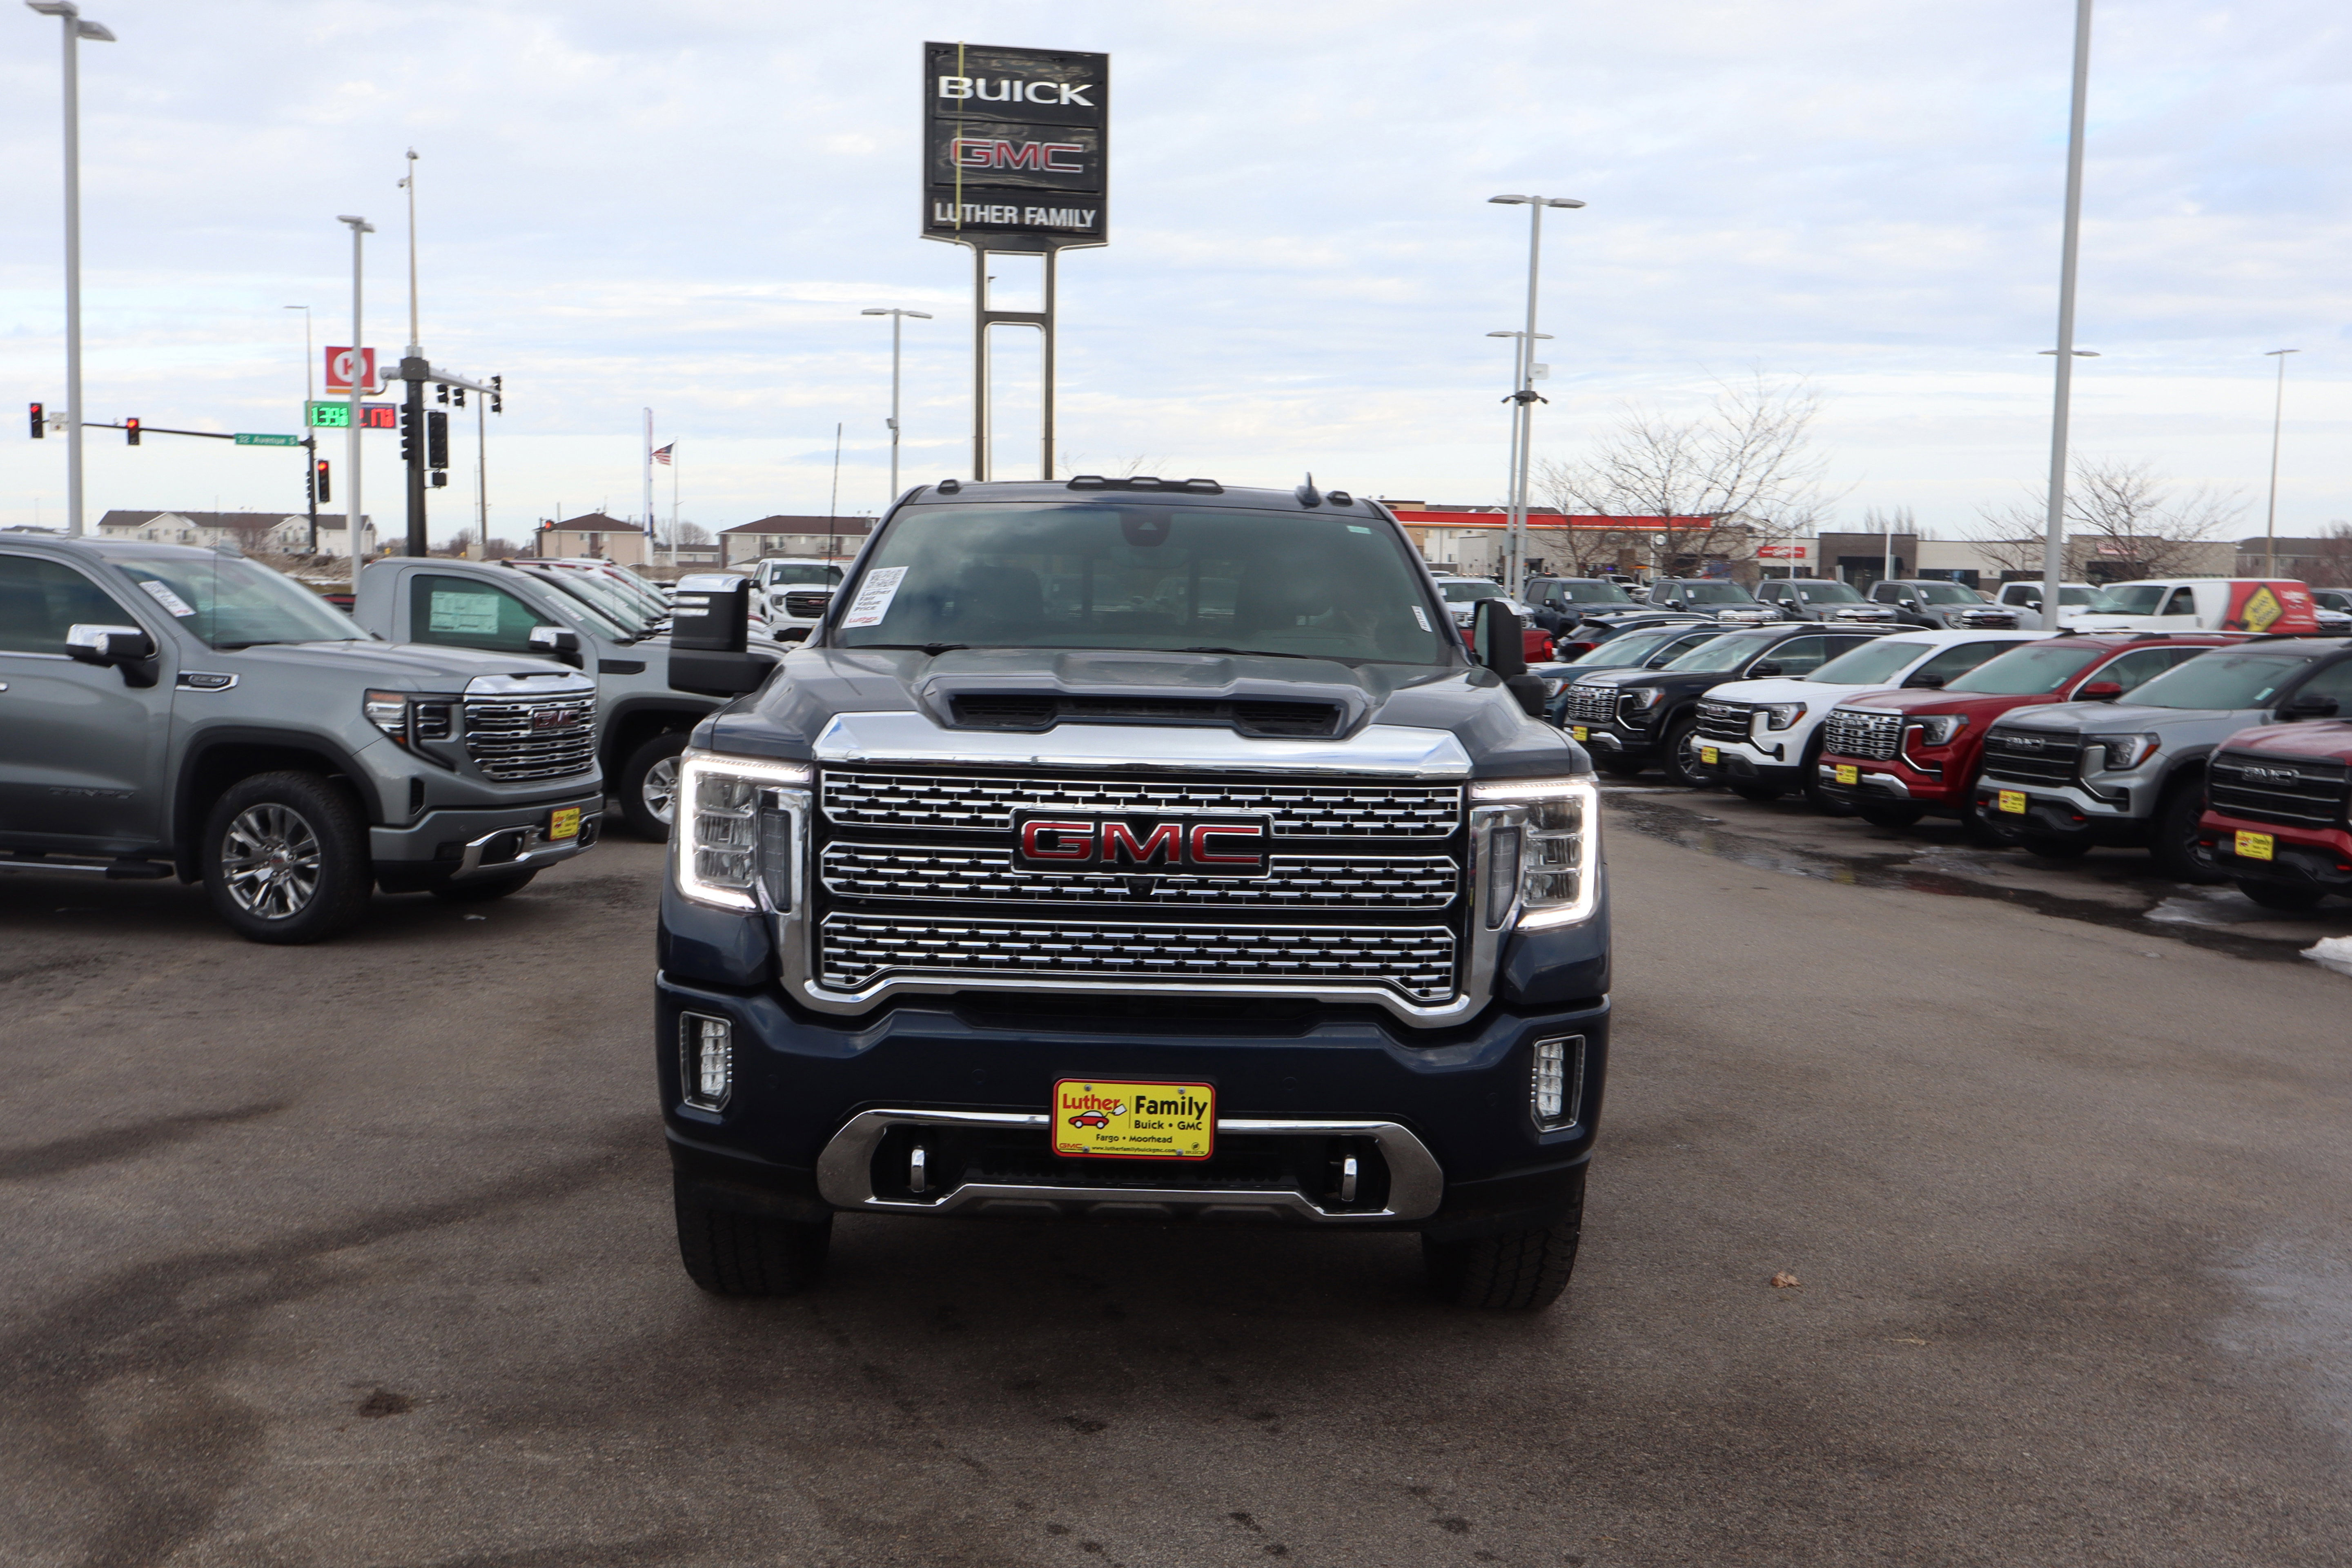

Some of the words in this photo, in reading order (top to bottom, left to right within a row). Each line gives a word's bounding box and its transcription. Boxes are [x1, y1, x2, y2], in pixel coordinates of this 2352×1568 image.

[939, 76, 1095, 106] BUICK
[950, 137, 1084, 174] GMC
[935, 202, 1018, 224] LUTHER
[1025, 206, 1096, 228] FAMILY
[252, 436, 285, 445] Avenue
[1021, 820, 1263, 866] GMC
[1062, 1093, 1120, 1110] Luther
[1135, 1096, 1208, 1120] Family
[1096, 1134, 1119, 1143] Fargo
[1134, 1120, 1164, 1129] Buick
[1177, 1121, 1202, 1131] GMC
